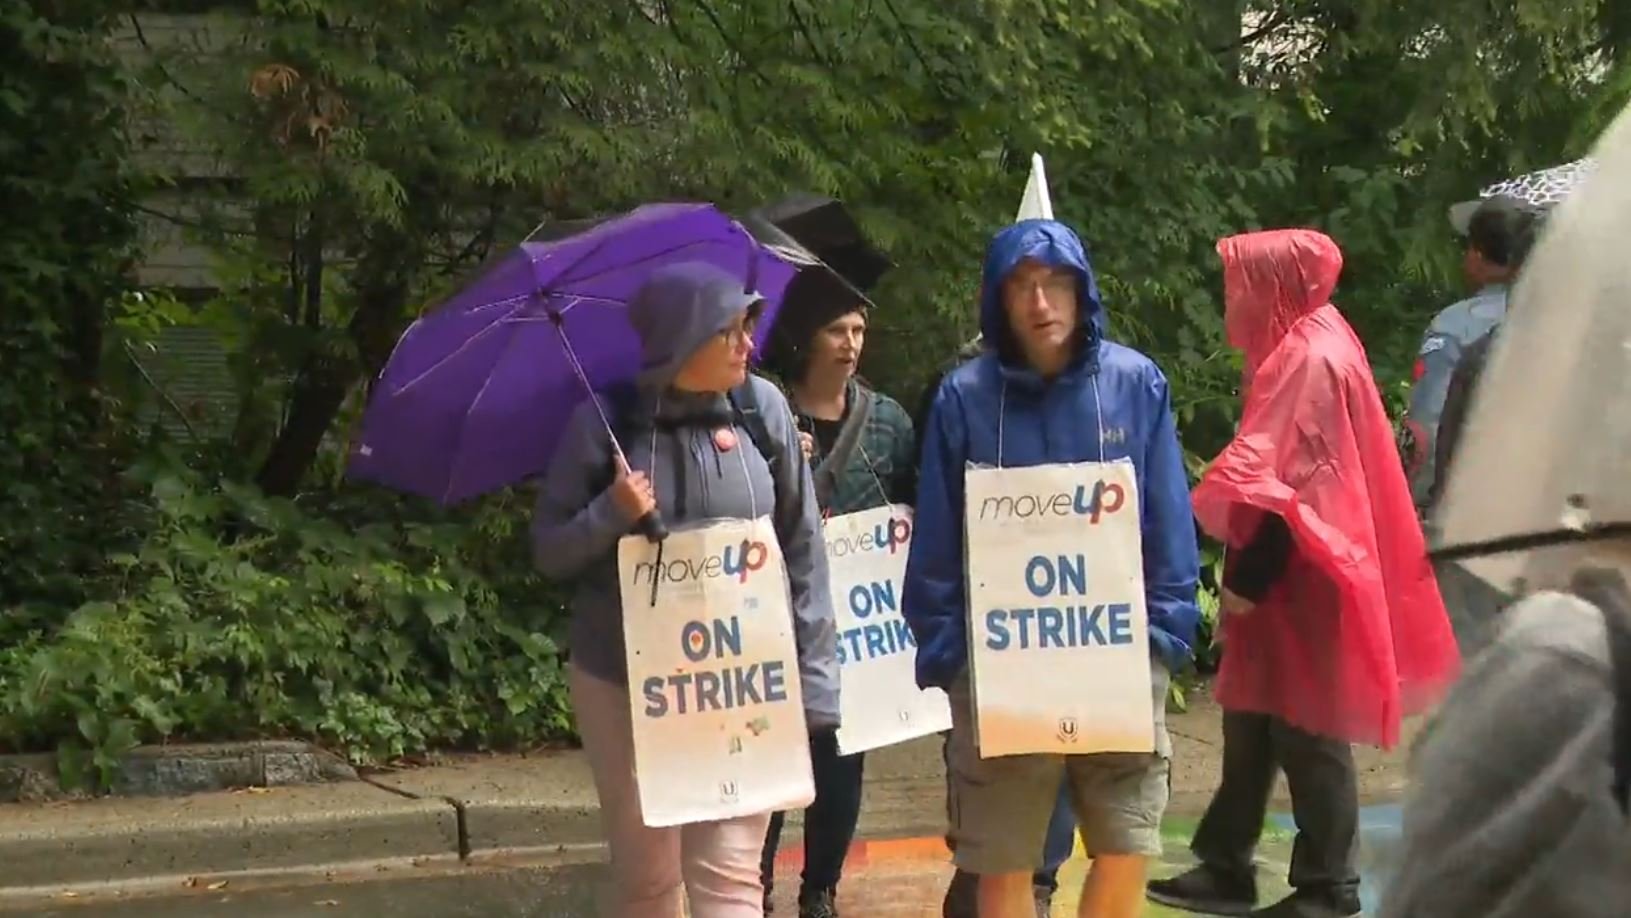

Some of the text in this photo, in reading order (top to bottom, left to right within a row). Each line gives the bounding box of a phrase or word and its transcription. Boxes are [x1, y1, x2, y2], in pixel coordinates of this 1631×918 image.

[1025, 554, 1087, 597] ON
[849, 579, 897, 619] ON
[681, 616, 742, 662] ON
[986, 604, 1134, 652] STRIKE
[643, 661, 788, 718] STRIKE
